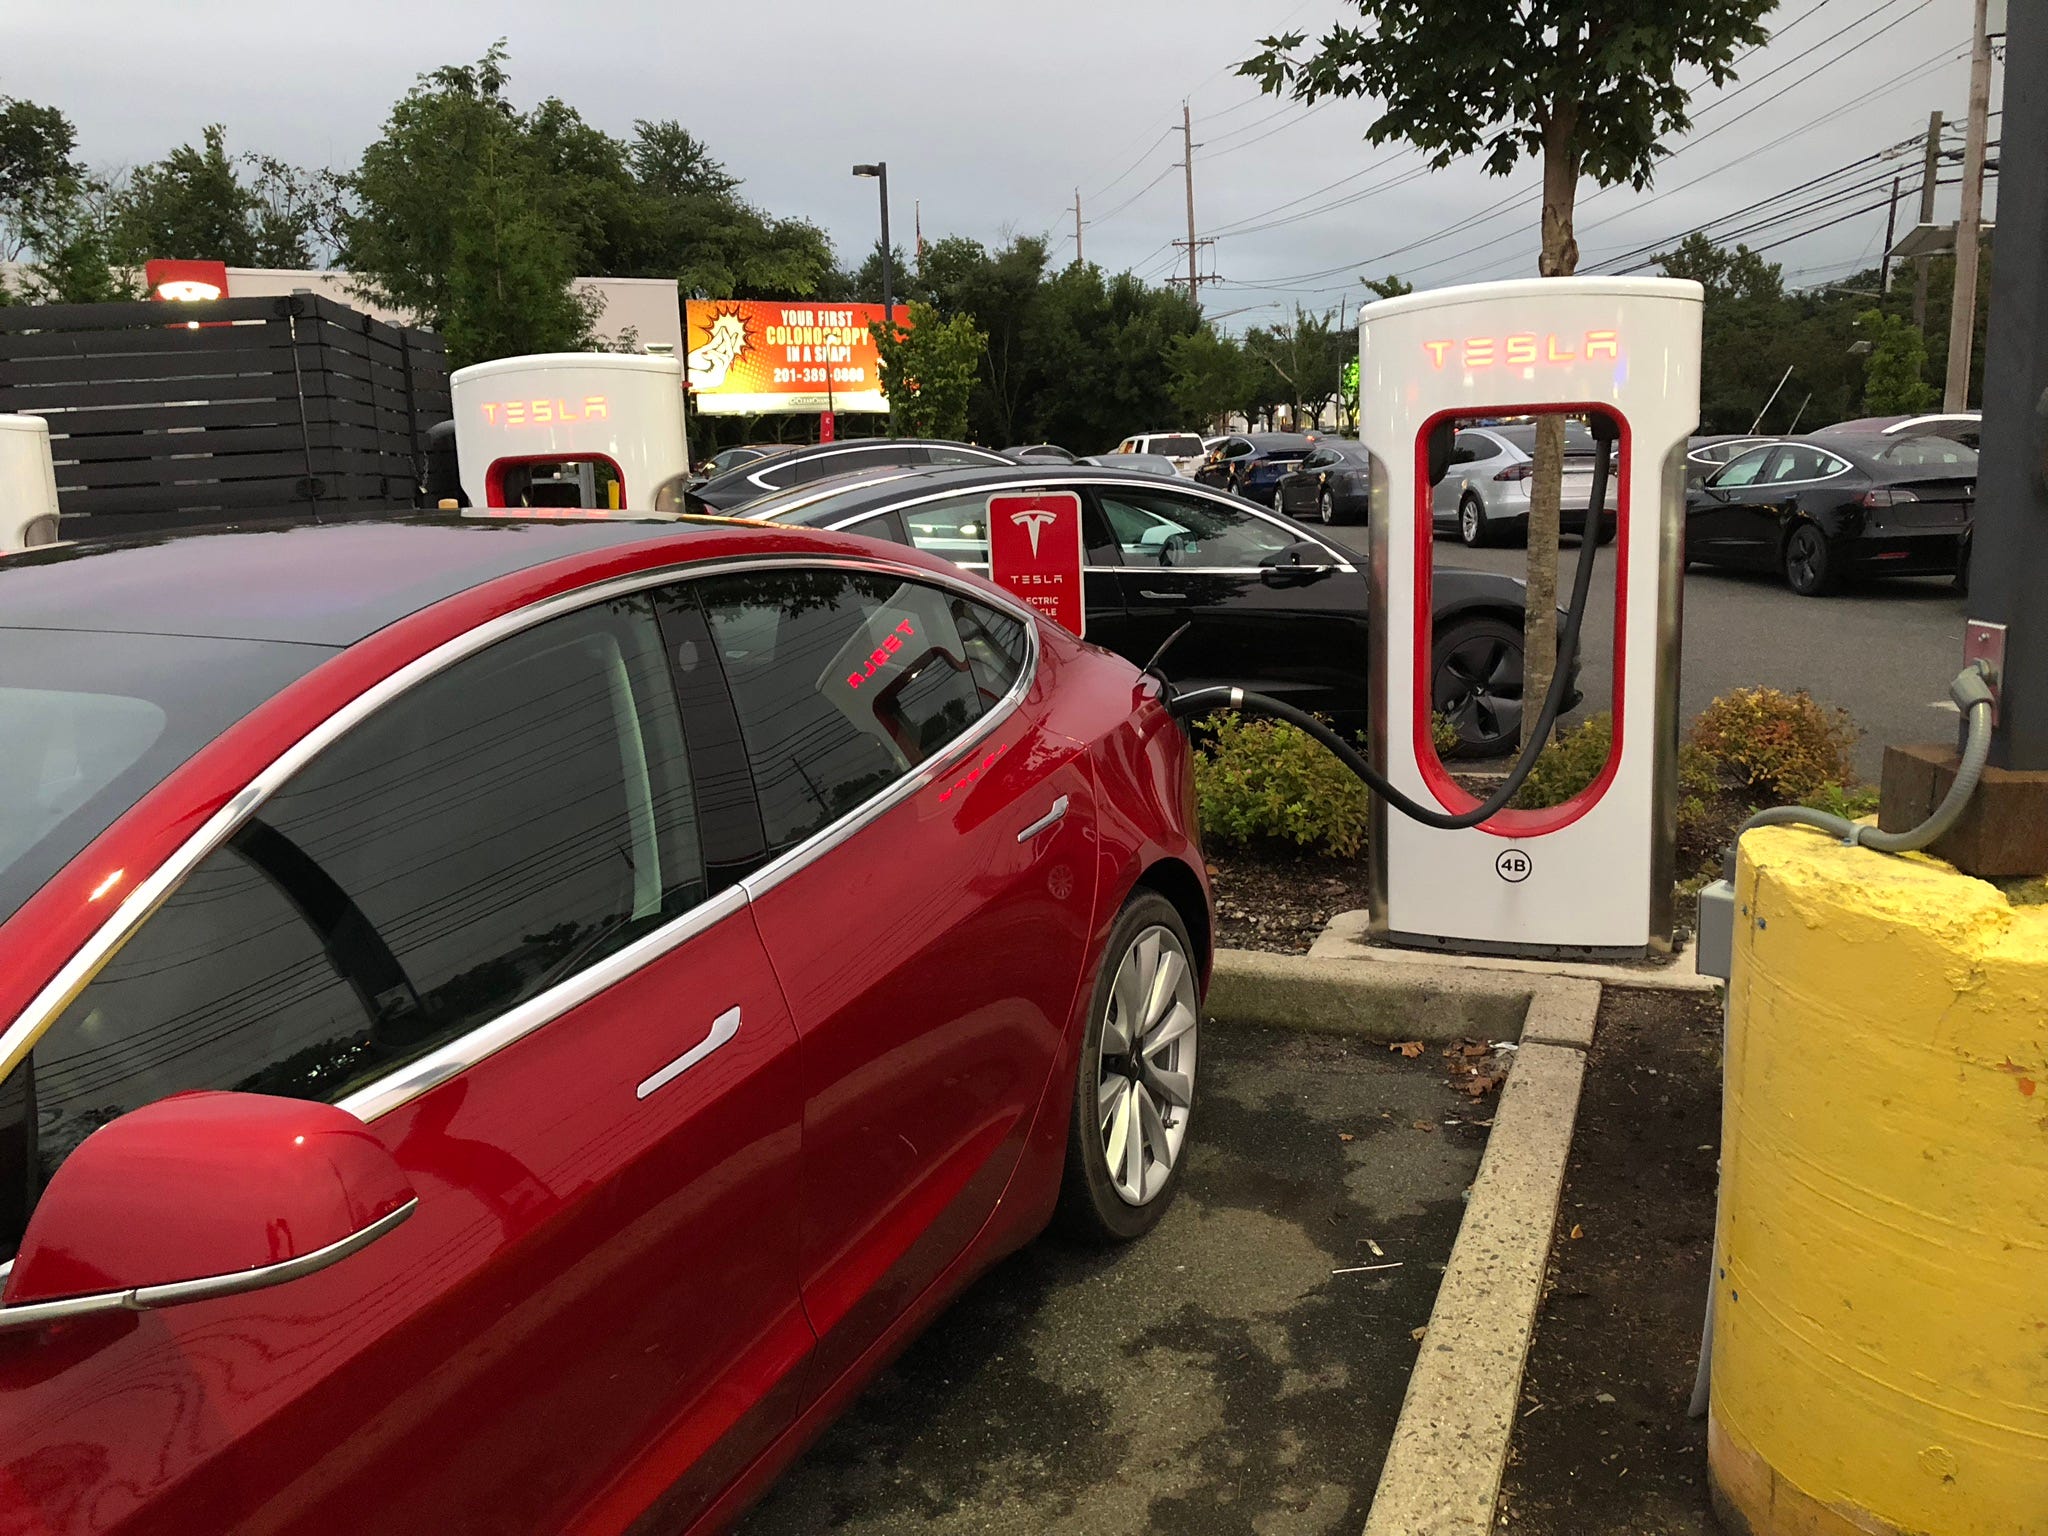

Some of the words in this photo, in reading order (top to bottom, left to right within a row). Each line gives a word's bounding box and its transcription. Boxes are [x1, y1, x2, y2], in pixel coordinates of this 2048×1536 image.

[781, 309, 814, 327] YOUR
[817, 310, 854, 327] FIRST
[786, 345, 800, 363] IN
[803, 345, 812, 363] A
[1424, 330, 1618, 369] TESLA
[483, 395, 608, 425] TESLA
[1010, 574, 1063, 584] TESLA
[1021, 596, 1059, 605] ECTRIC
[1501, 858, 1526, 871] 4B
